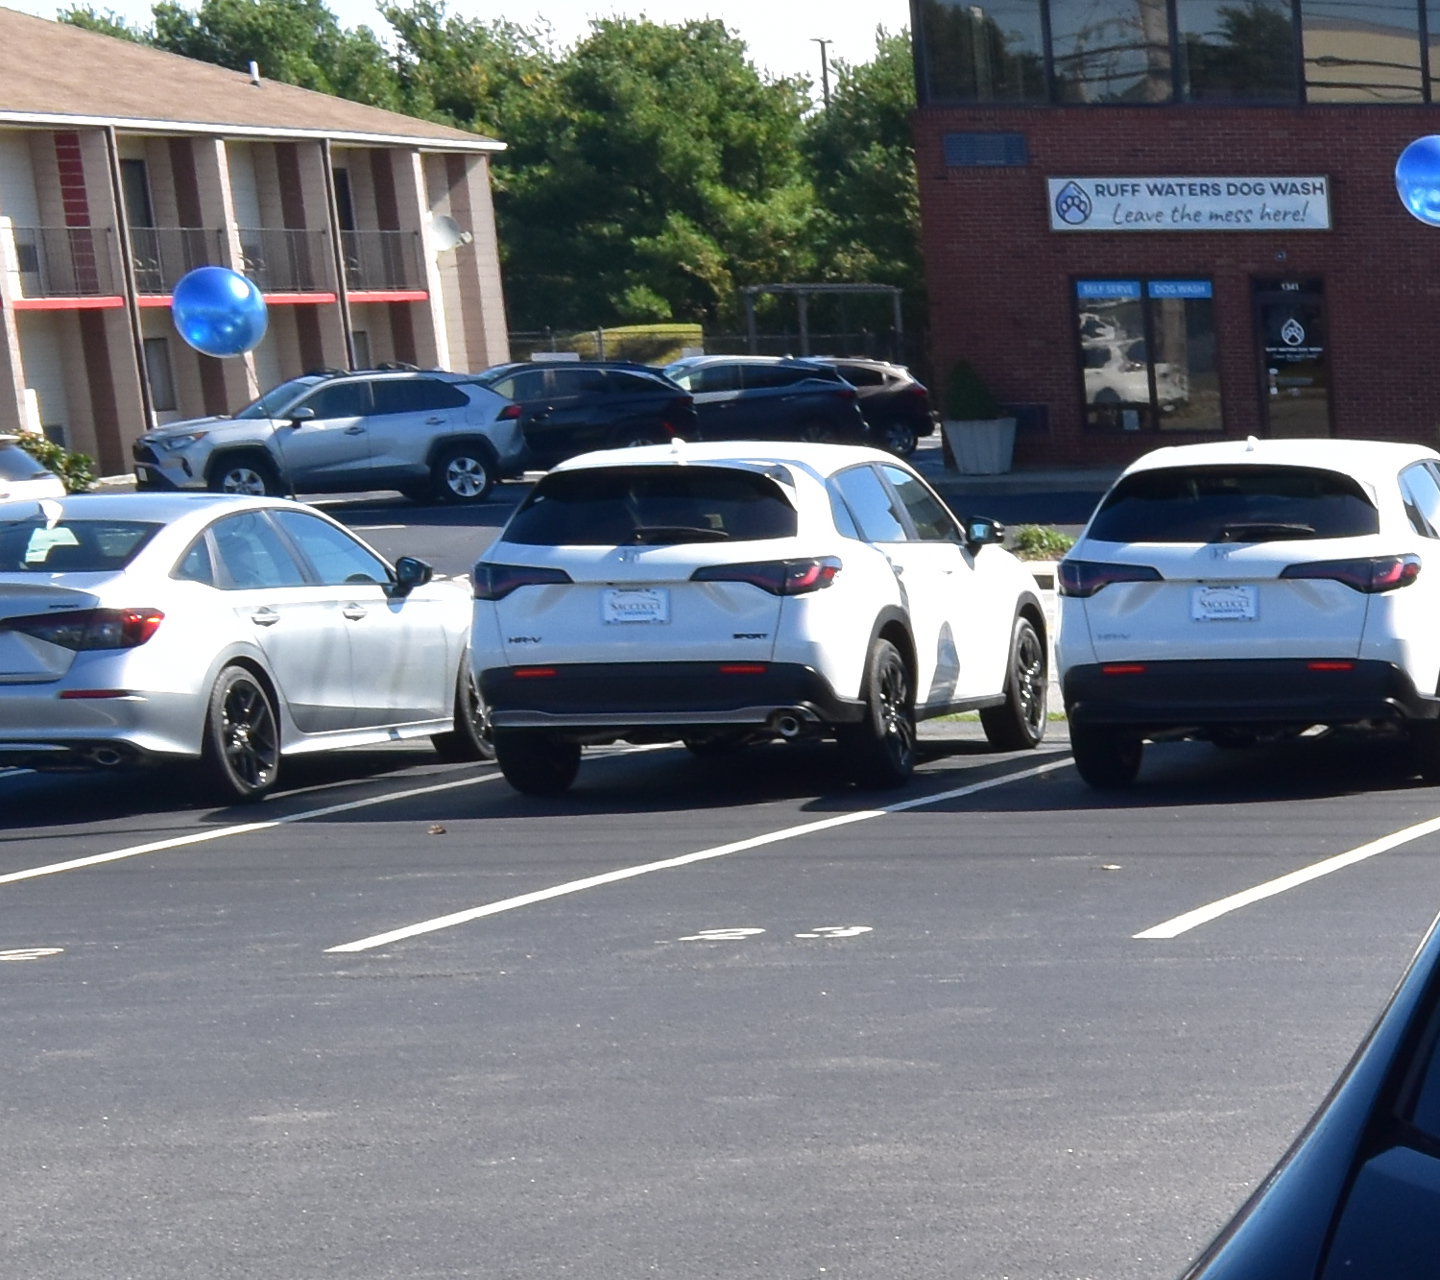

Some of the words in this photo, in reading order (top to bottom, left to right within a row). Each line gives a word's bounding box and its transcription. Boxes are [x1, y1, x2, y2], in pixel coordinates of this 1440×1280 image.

[1095, 183, 1141, 197] RUFF
[1146, 183, 1222, 197] WATERS
[1226, 182, 1266, 196] DOG
[1270, 182, 1324, 196] WASH
[1113, 203, 1163, 224] Leave
[1170, 203, 1202, 223] the
[1208, 208, 1253, 223] mess
[1259, 201, 1310, 223] here!
[1154, 284, 1176, 295] DOG
[1178, 284, 1205, 295] WASH
